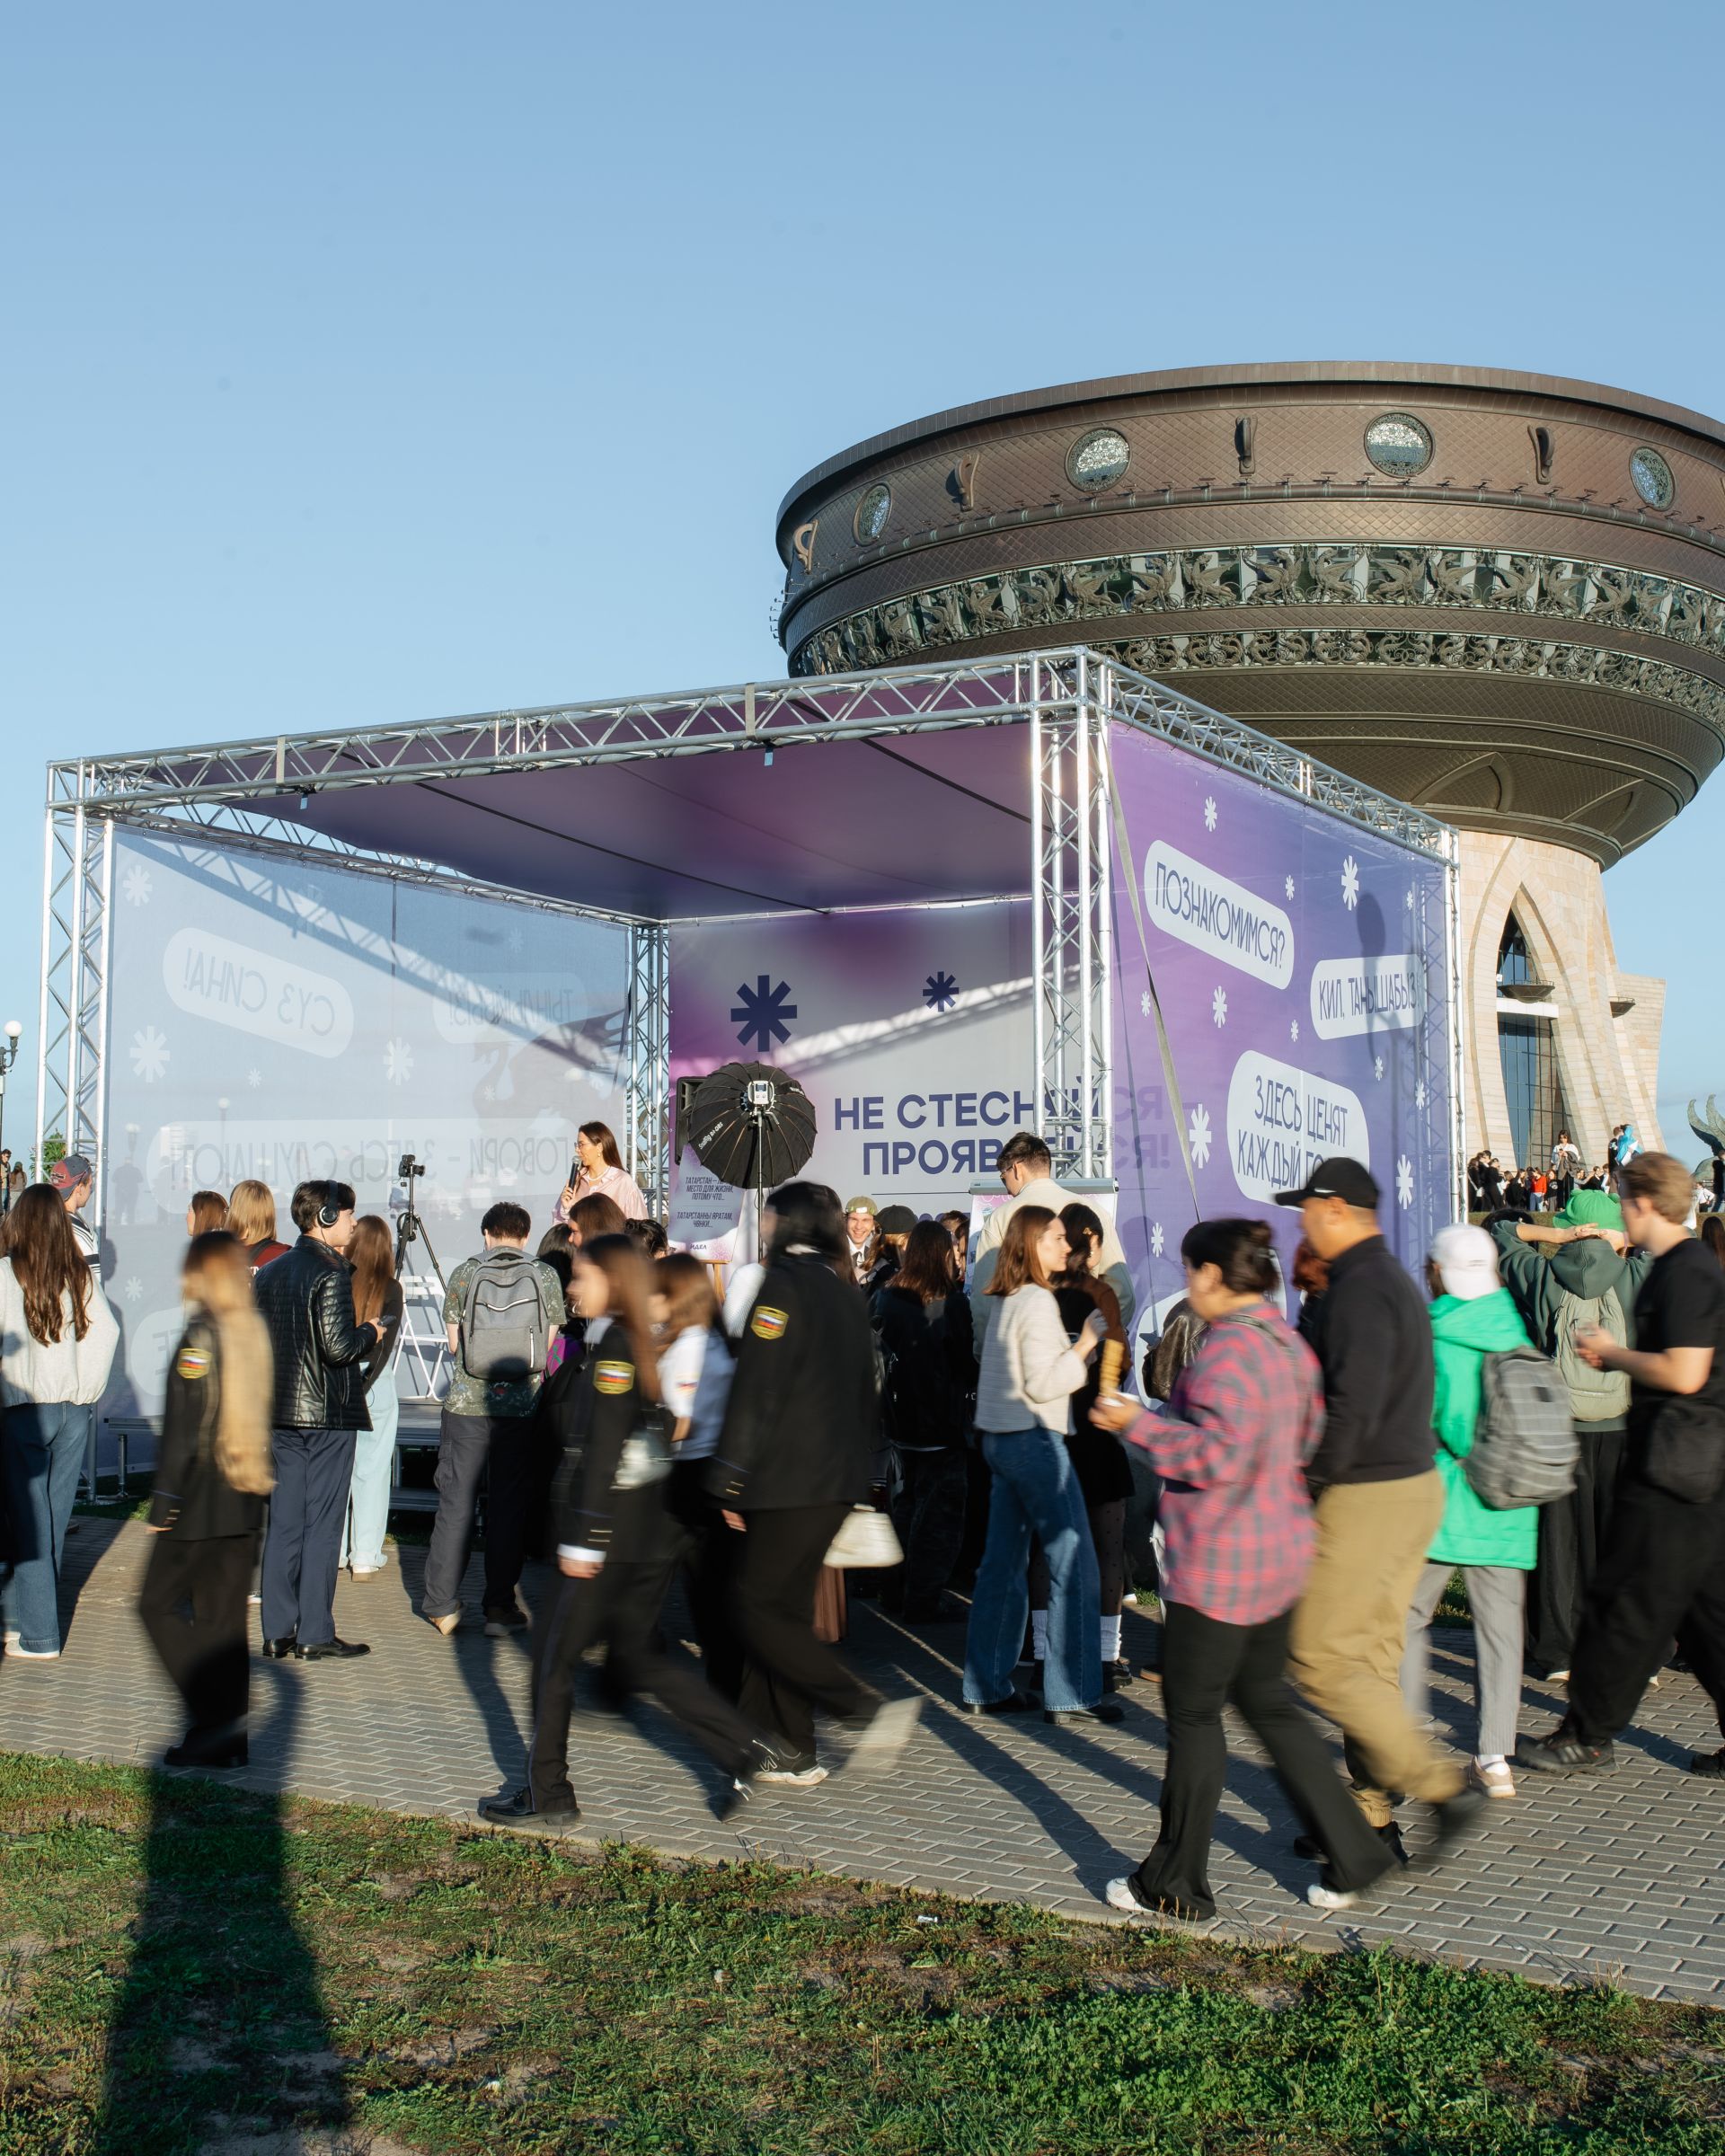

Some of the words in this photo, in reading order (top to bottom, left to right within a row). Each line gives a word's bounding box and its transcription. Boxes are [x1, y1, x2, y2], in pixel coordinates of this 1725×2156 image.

[1155, 861, 1286, 969] ПОЗНАКОМИМСЯ?
[1319, 978, 1345, 1021] КИЛ,
[835, 1096, 884, 1131] НЕ
[1254, 1074, 1303, 1133] ЗДЕСЬ
[1307, 1094, 1348, 1148] ЦЕНЯТ
[863, 1125, 1171, 1175] ПРОЯВСЯ!
[1237, 1128, 1302, 1190] КАЖДЫЙ
[686, 1185, 703, 1193] МЕСТО
[703, 1185, 714, 1193] ДЛЯ
[714, 1185, 733, 1194] ЖИЗНИ,
